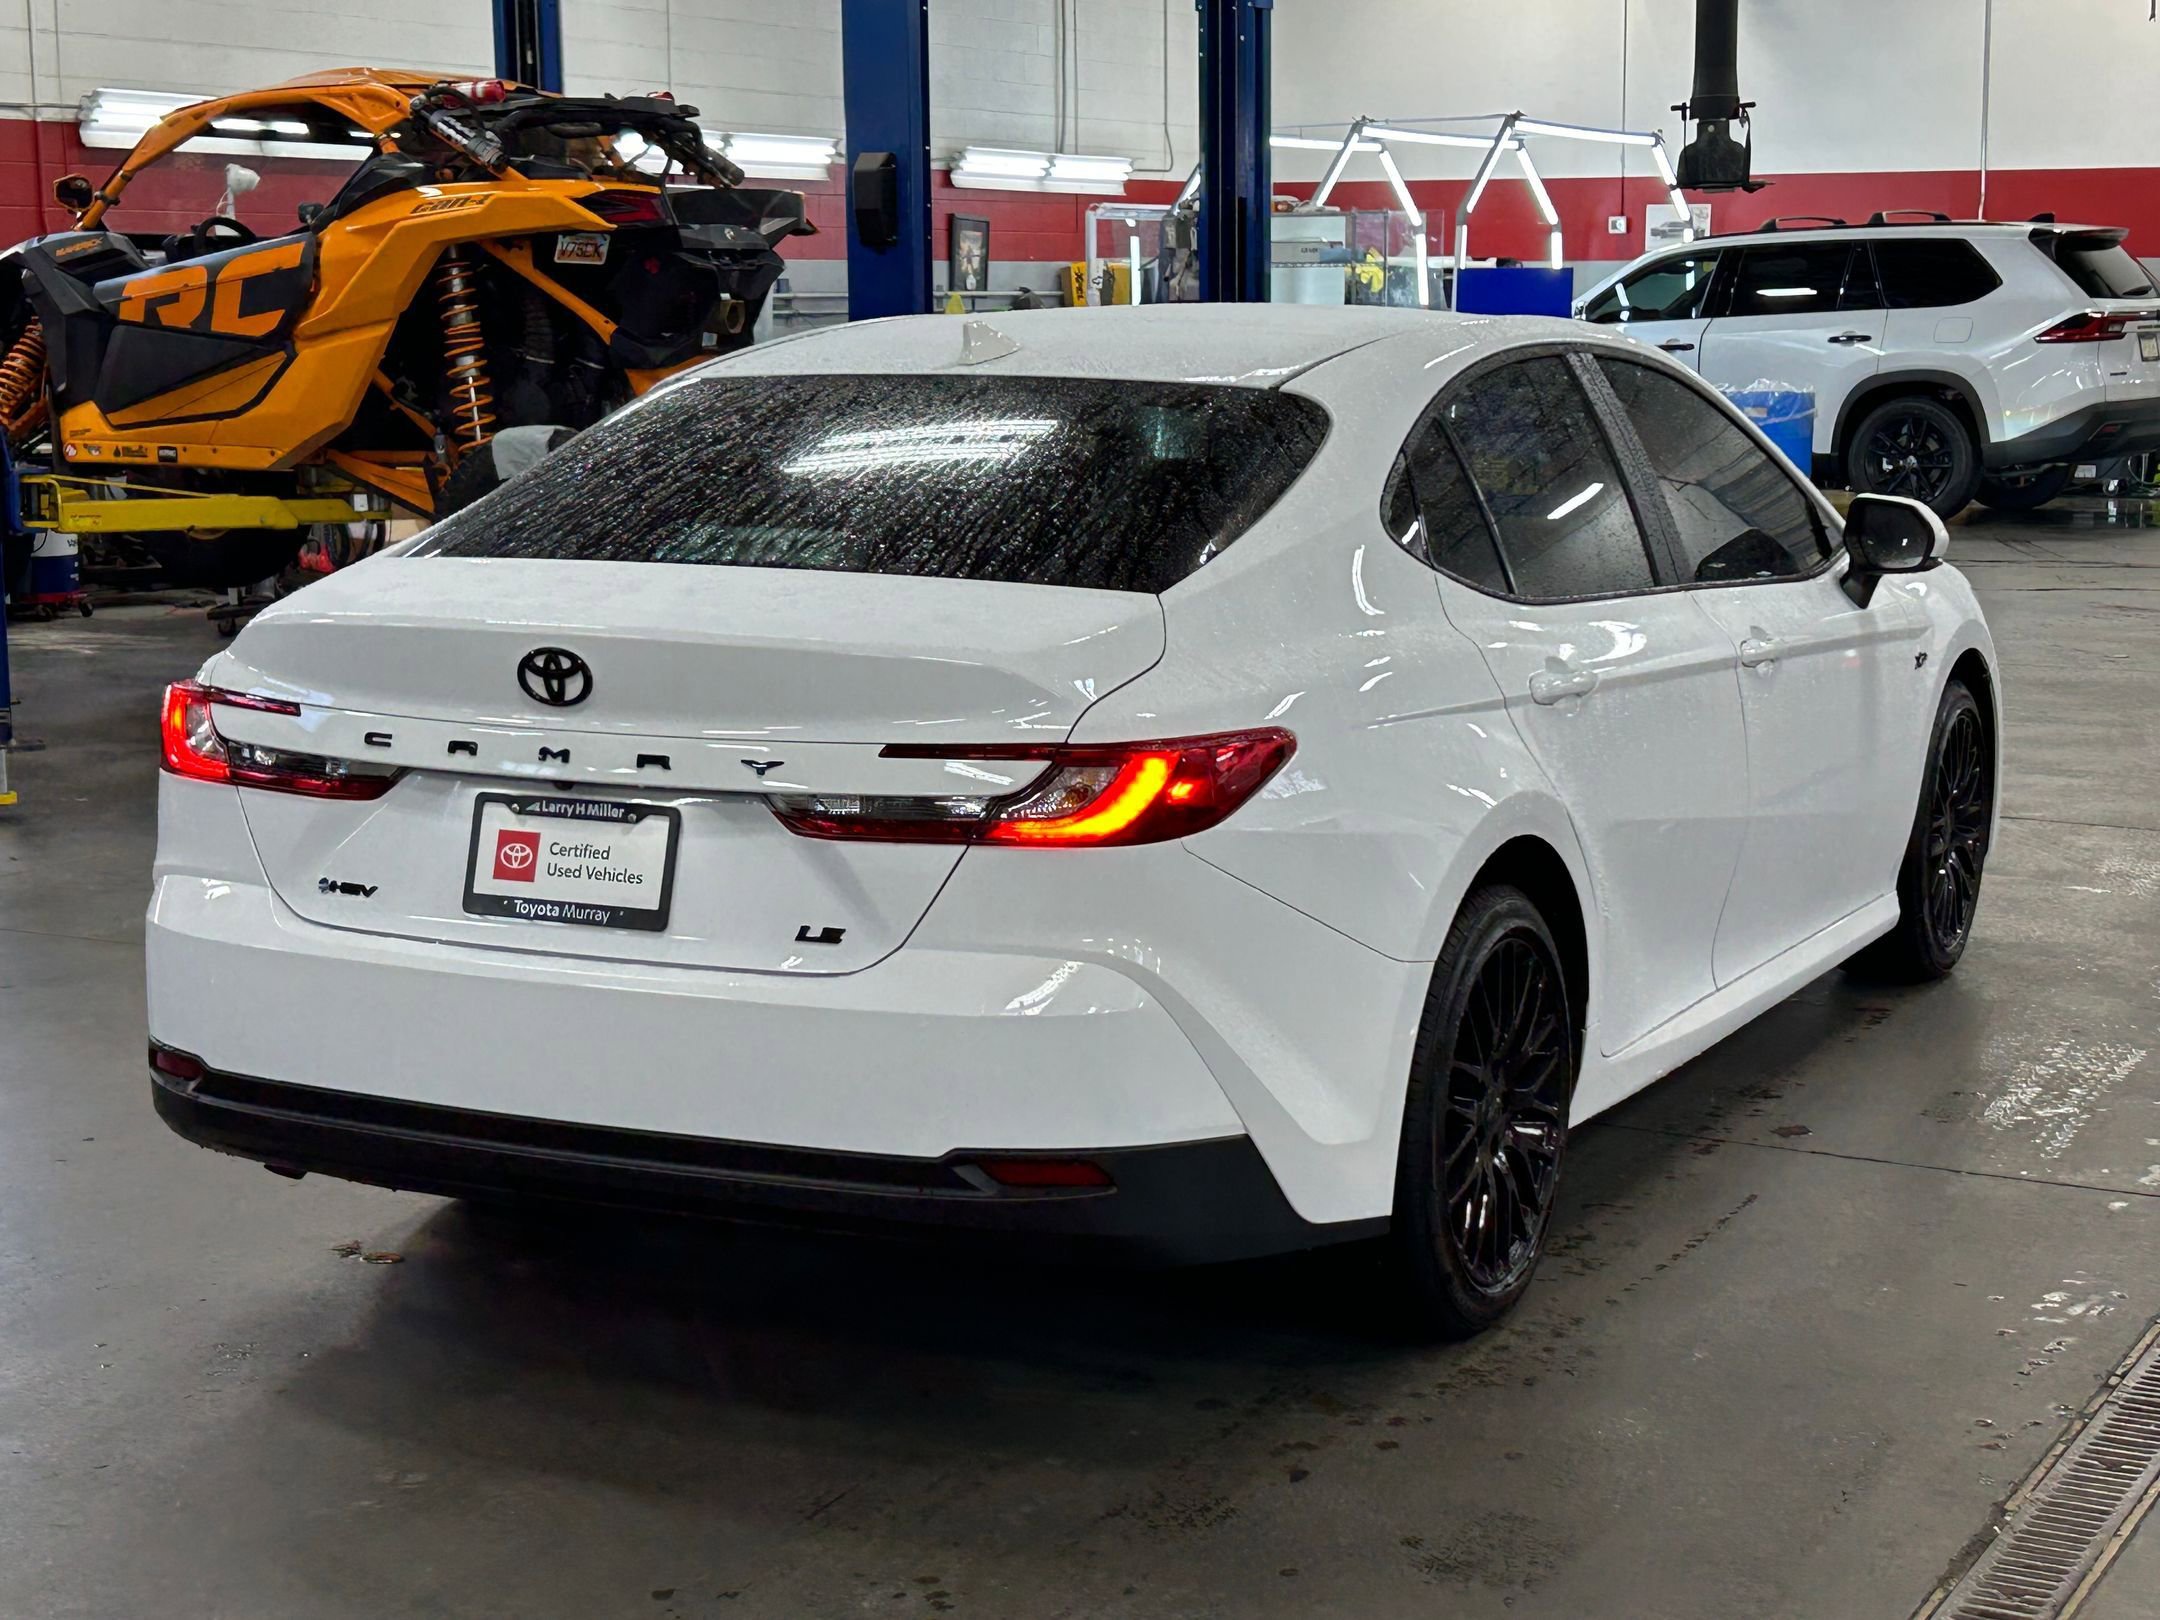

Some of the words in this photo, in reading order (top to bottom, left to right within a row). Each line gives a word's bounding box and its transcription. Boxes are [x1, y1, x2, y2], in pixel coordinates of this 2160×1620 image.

[363, 731, 785, 776] CAMRY
[542, 799, 575, 818] Larry
[575, 802, 586, 816] H
[586, 803, 625, 819] Miller
[550, 841, 611, 861] Certified
[547, 862, 582, 879] Used
[585, 865, 643, 885] Vehicles
[514, 899, 560, 918] Toyota
[562, 903, 611, 925] Murray
[794, 924, 847, 945] LE
